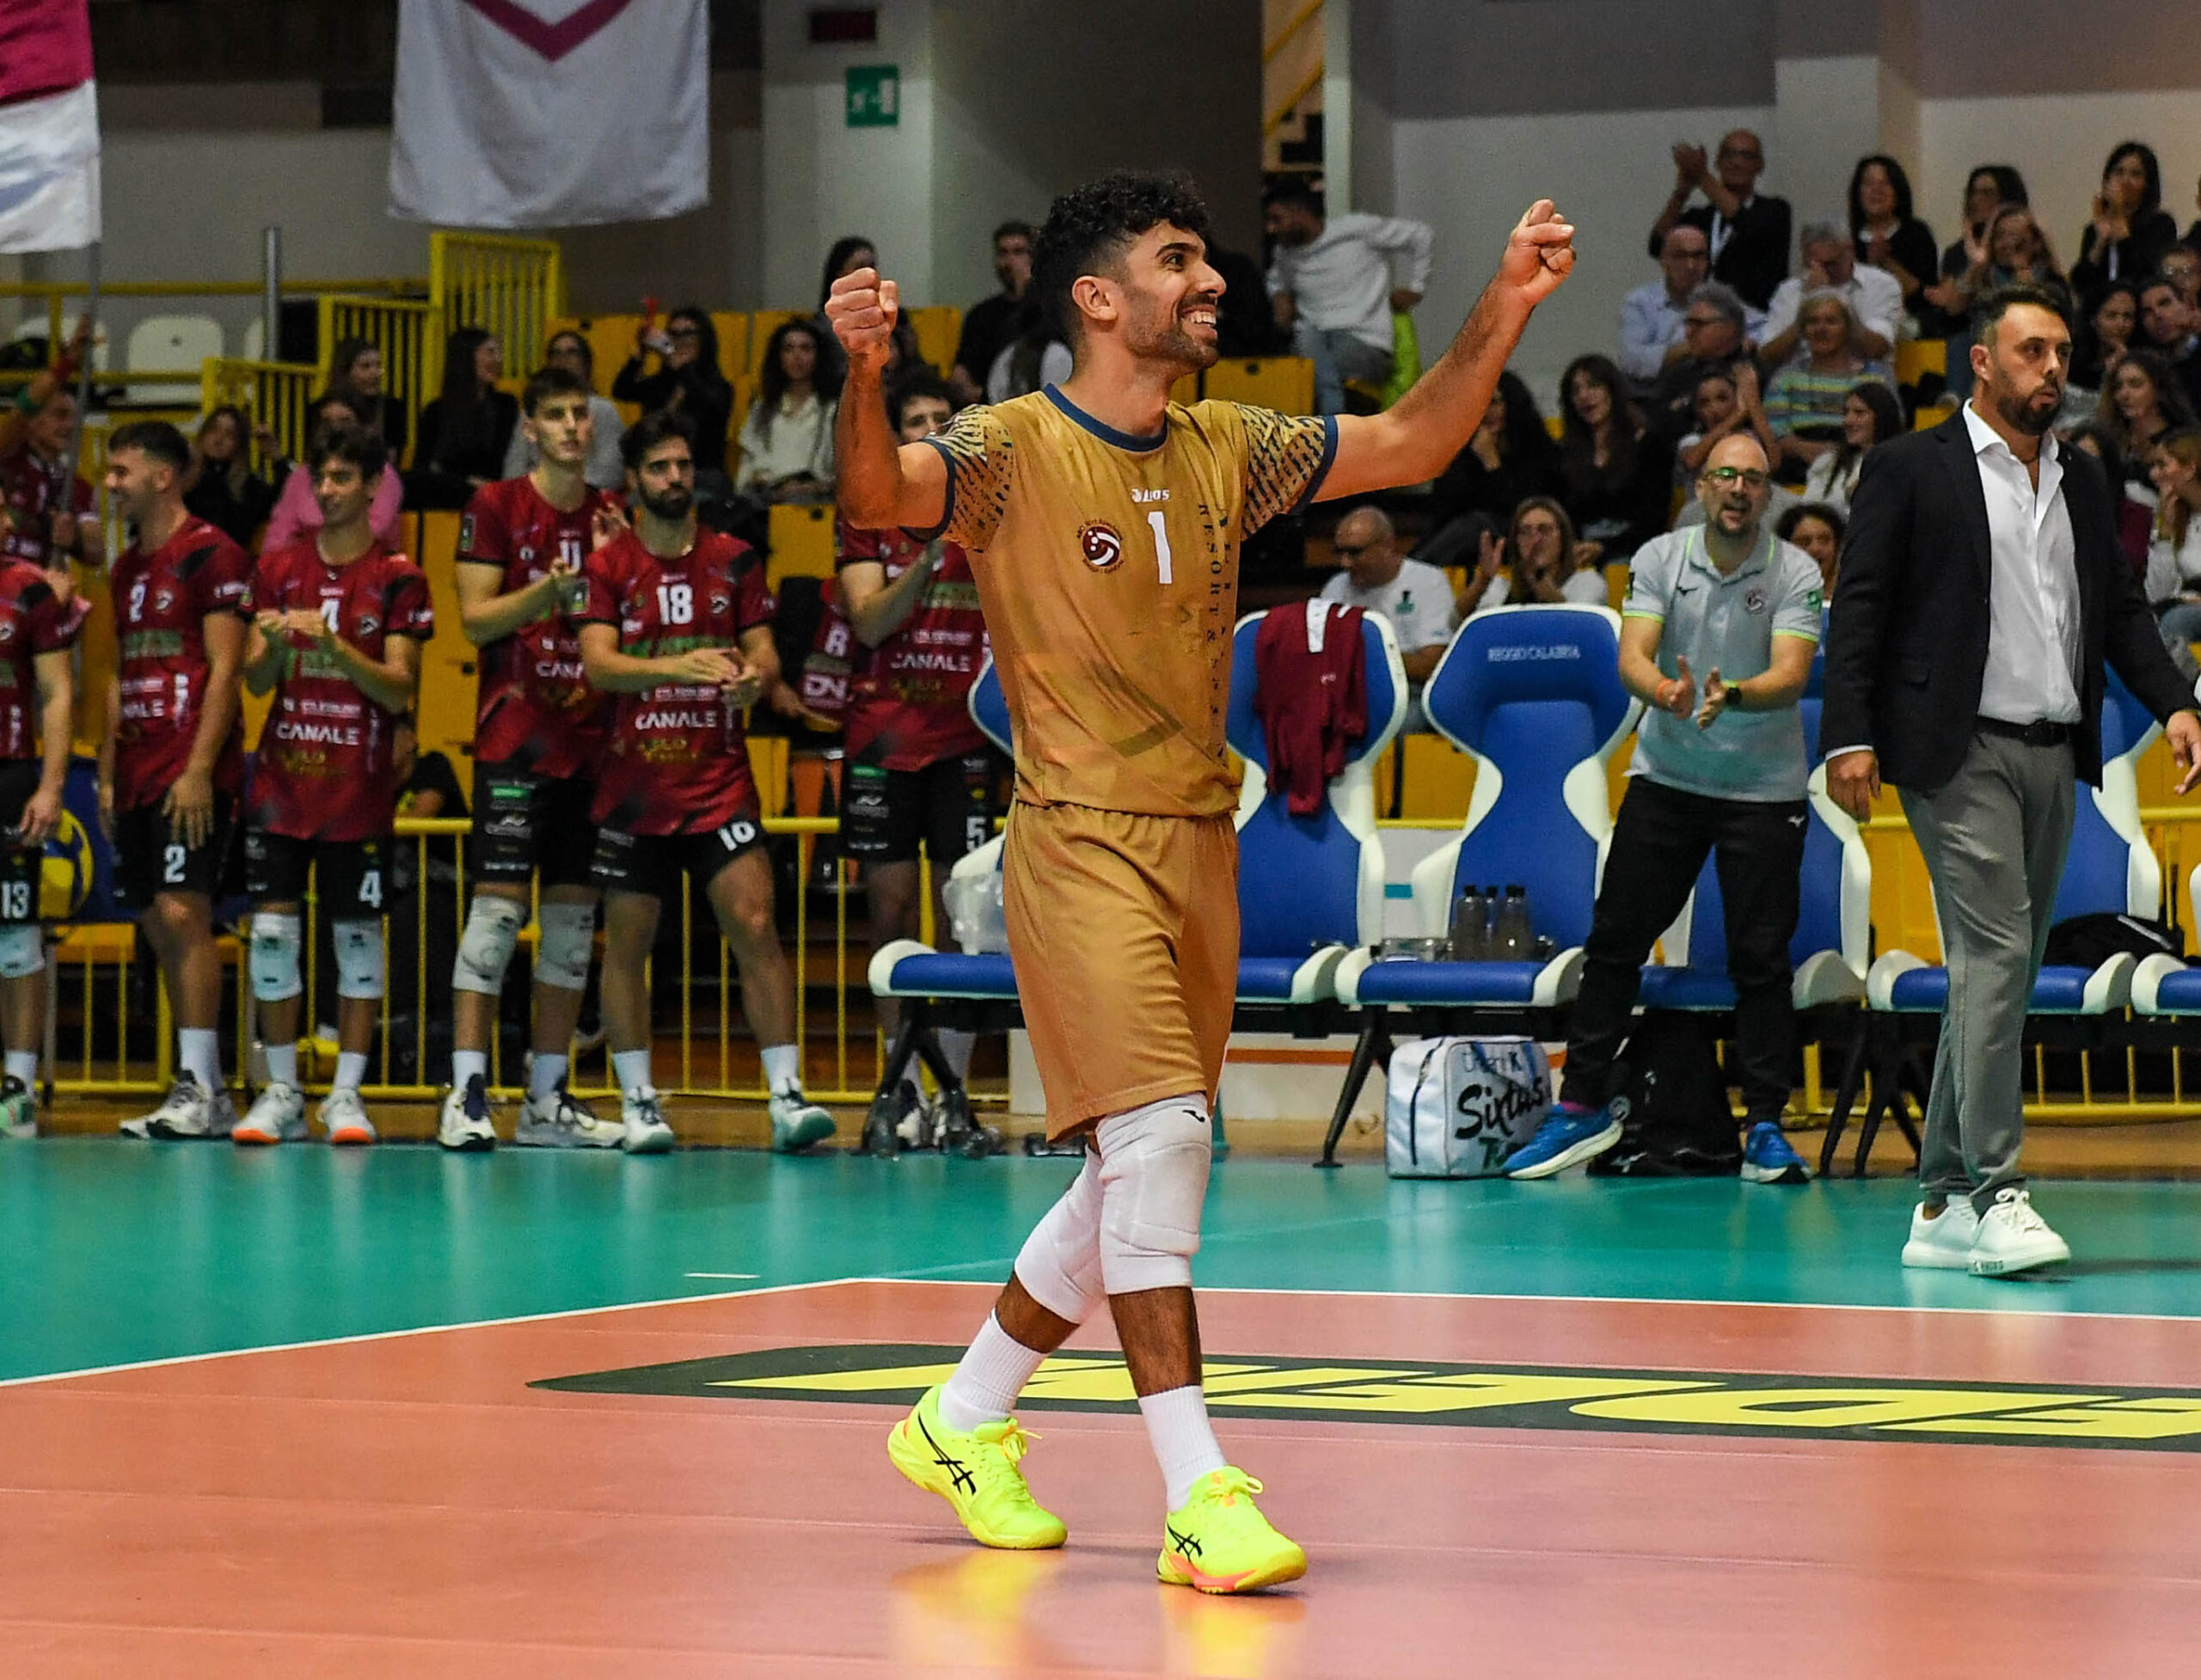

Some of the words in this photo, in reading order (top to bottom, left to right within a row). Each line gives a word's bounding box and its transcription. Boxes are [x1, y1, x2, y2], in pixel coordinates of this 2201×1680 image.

[1148, 512, 1172, 584] 1
[656, 584, 694, 626] 18
[276, 720, 360, 745] CANALE
[635, 709, 718, 731] CANALE
[966, 816, 986, 851] 5
[163, 846, 186, 883] 2
[1, 880, 30, 919] 13
[359, 869, 383, 908] 4
